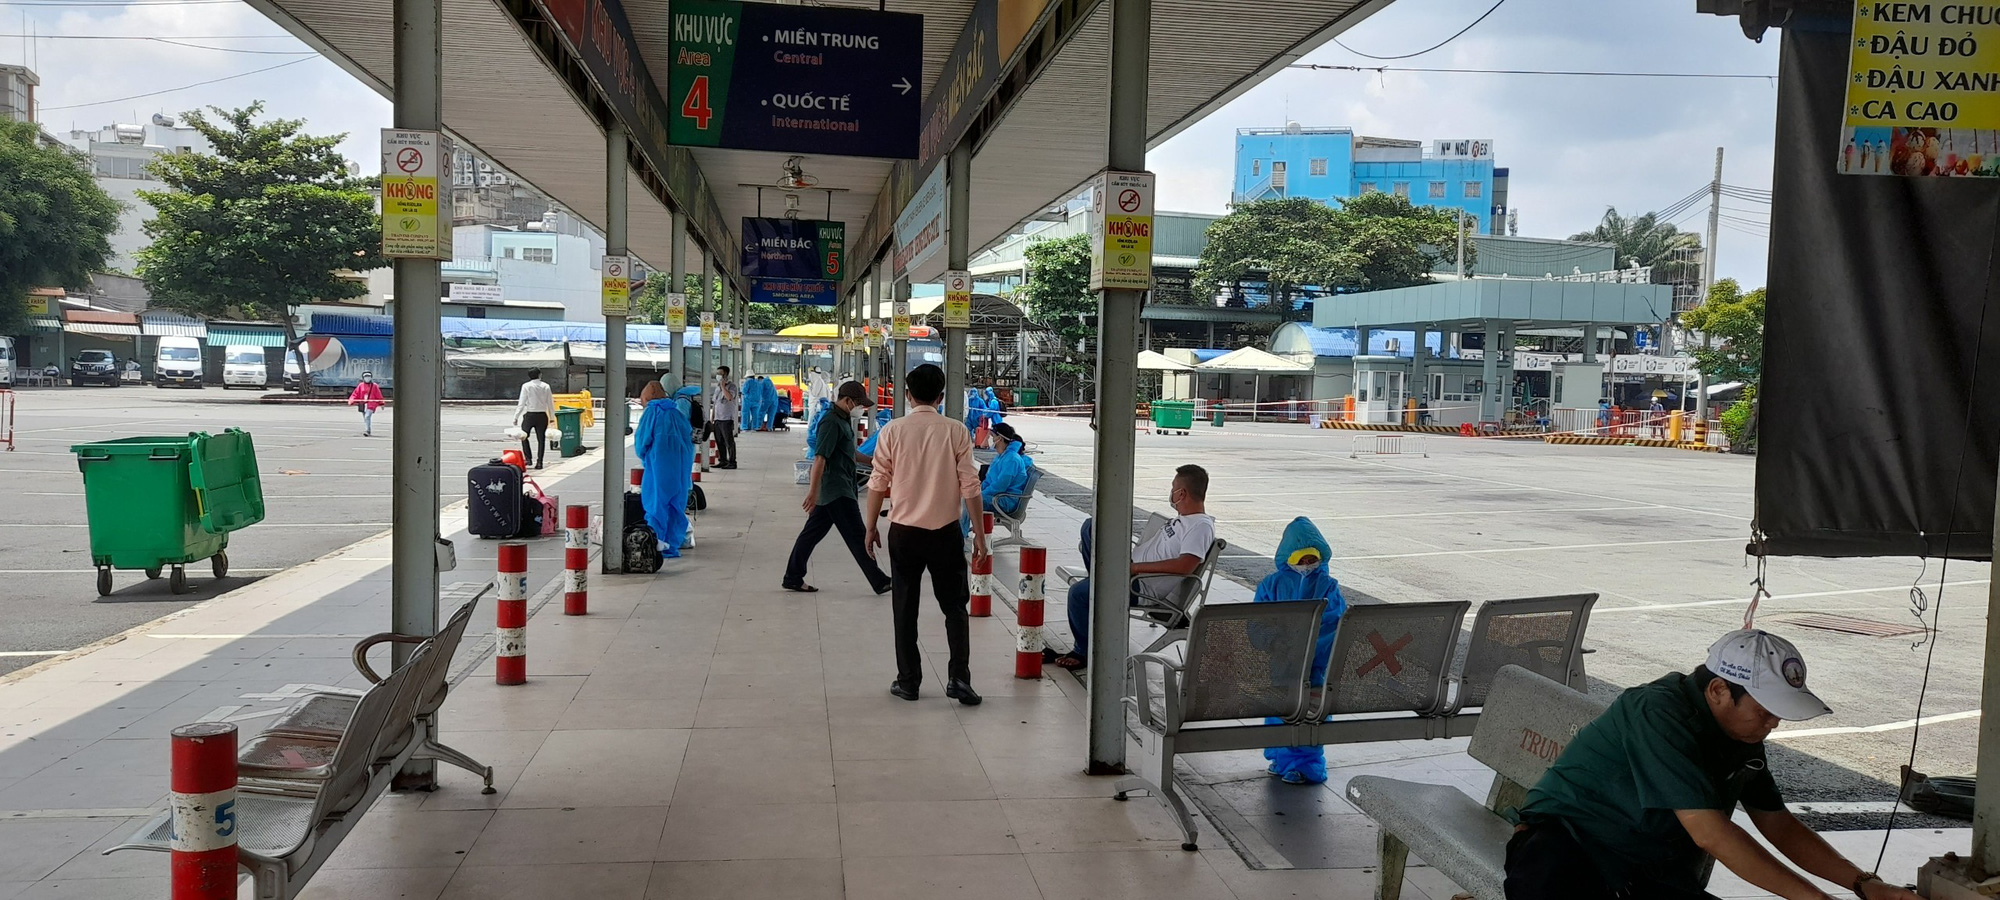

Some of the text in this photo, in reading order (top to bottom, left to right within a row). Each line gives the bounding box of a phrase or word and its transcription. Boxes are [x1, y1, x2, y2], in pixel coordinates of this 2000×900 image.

[1873, 3, 2000, 25] KEM CHU
[675, 12, 733, 53] KHU VỰC
[774, 27, 879, 50] MIỀN TRUNG
[1870, 30, 1977, 59] ĐẬU ĐỎ
[678, 47, 711, 66] Area
[774, 50, 823, 65] Central
[966, 17, 985, 97] BẮC
[1867, 64, 1925, 93] ĐẬU
[681, 75, 712, 130] 4
[772, 91, 851, 111] QUỐC TẾ
[1862, 100, 1958, 121] CA CAO
[771, 115, 860, 132] International
[387, 177, 434, 200] KHÔNG
[819, 228, 831, 239] KHU
[1108, 217, 1149, 237] KHÔNG
[761, 236, 811, 249] MIỀN BẮC
[761, 251, 792, 260] Northern
[826, 252, 839, 275] 5
[351, 357, 384, 366] pepsi
[475, 484, 507, 527] POLO TWIN
[215, 798, 235, 837] 5
